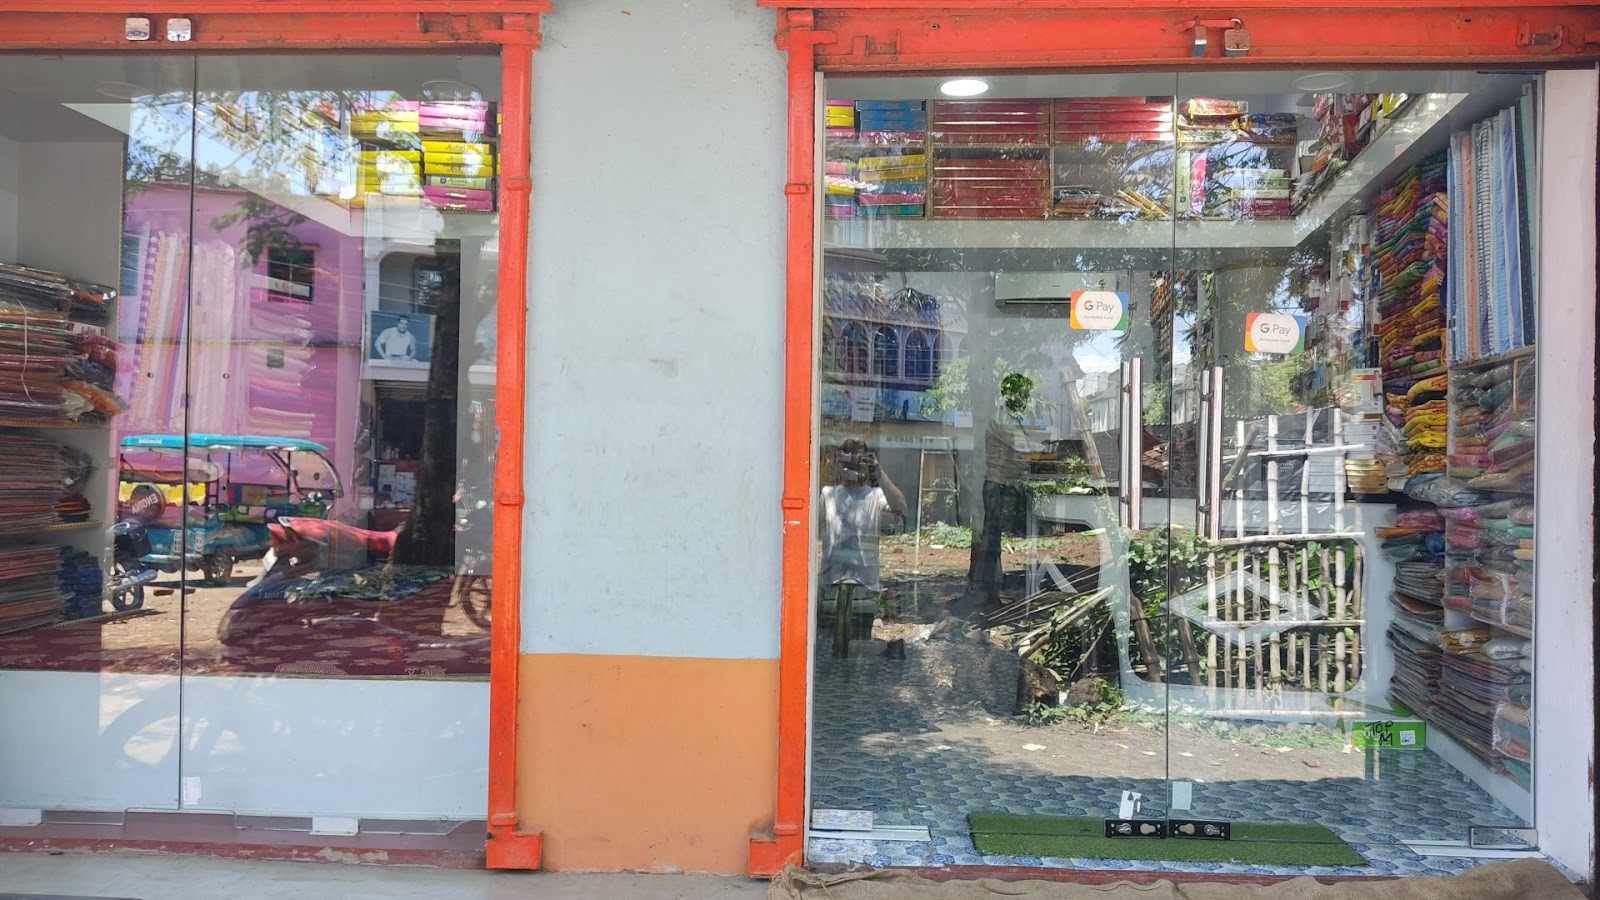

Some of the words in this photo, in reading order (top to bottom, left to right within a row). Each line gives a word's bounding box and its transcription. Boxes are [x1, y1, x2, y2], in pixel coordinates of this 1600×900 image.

[1084, 300, 1094, 311] G
[1096, 301, 1115, 314] Pay
[1260, 322, 1270, 333] G
[1272, 323, 1291, 337] Pay
[1364, 720, 1394, 736] TOP
